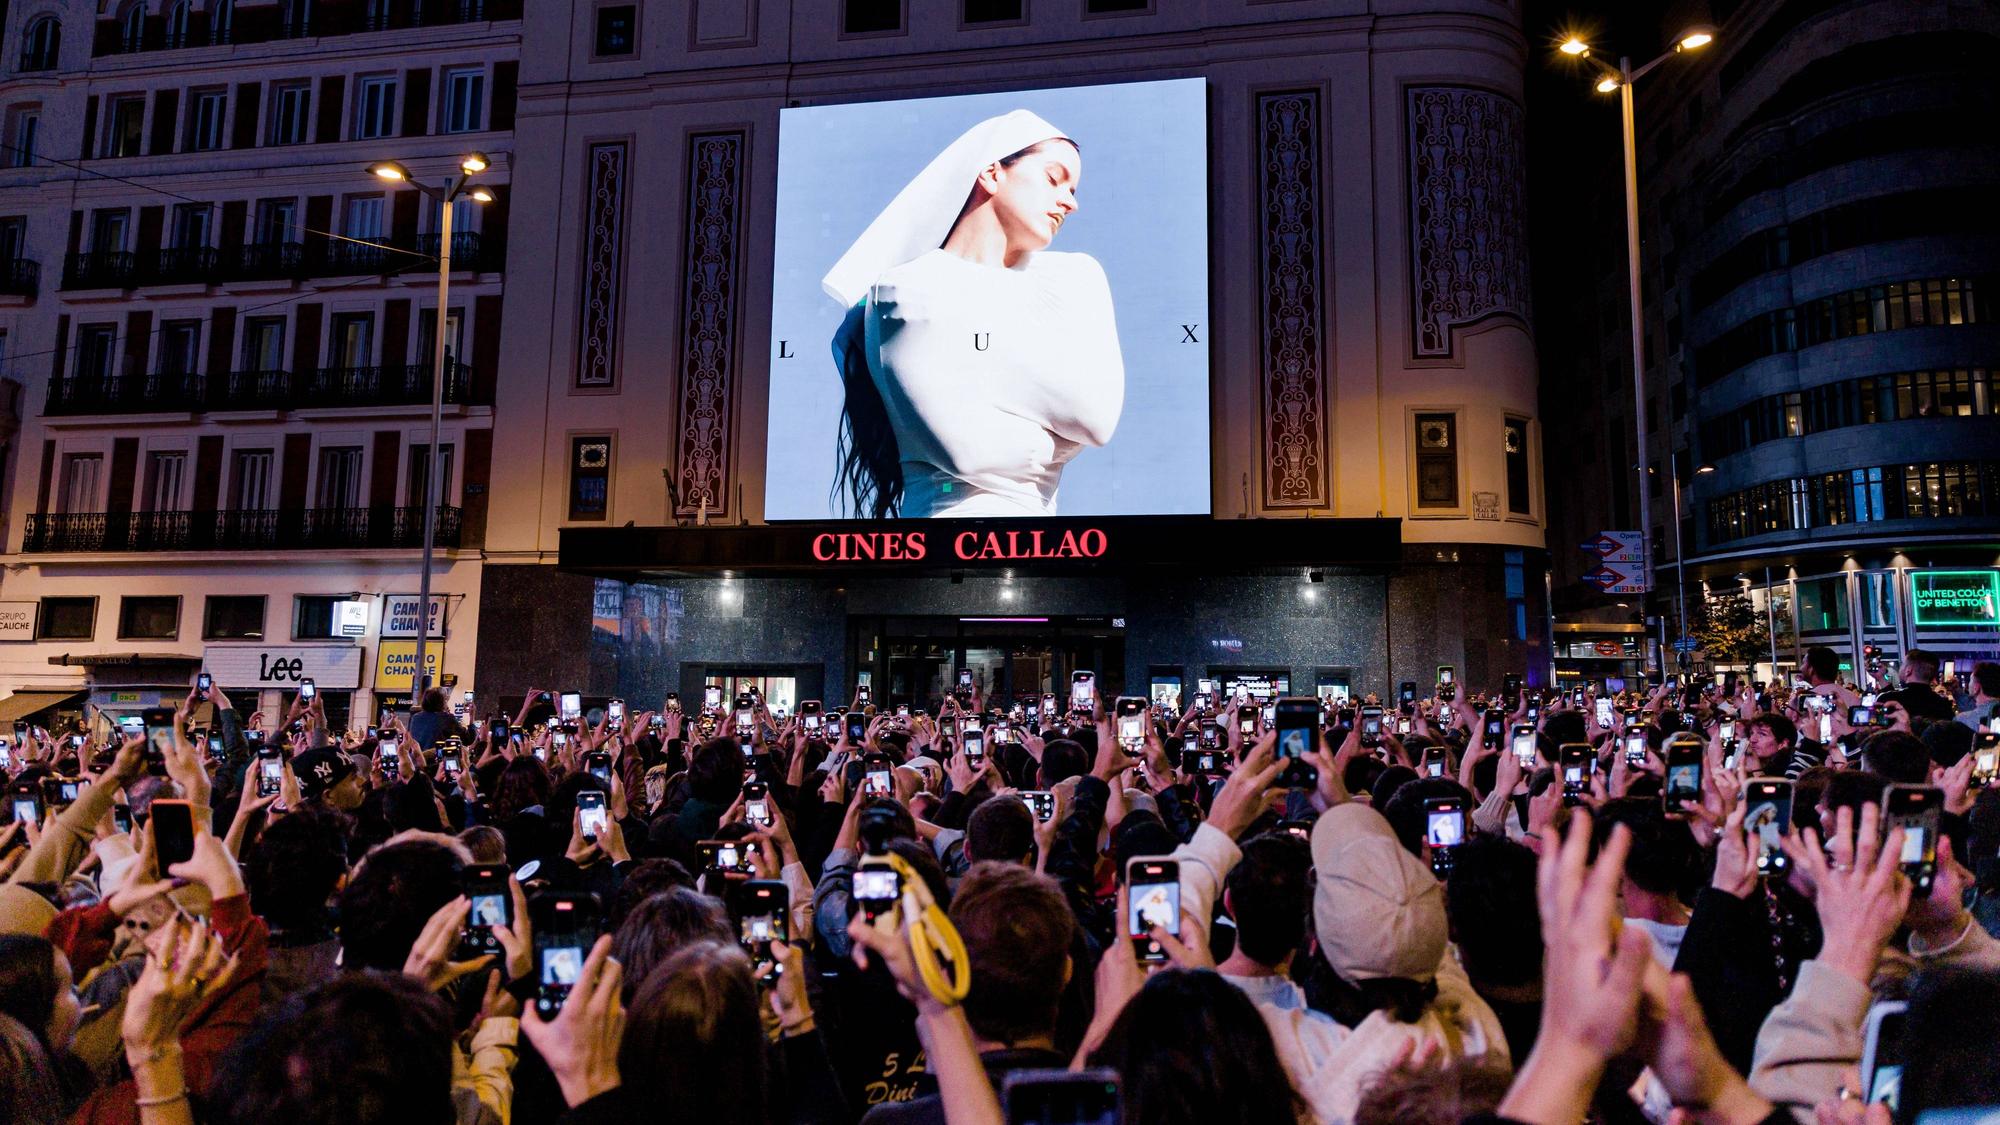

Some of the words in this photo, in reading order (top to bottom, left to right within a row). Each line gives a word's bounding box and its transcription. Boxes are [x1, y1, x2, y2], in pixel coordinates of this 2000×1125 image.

[778, 340, 794, 359] L
[973, 333, 990, 352] U
[1181, 324, 1199, 344] X
[812, 532, 926, 561] CINES
[954, 528, 1108, 560] CALLAO
[1917, 589, 1956, 598] UNITED
[1918, 599, 1933, 607] OF
[1934, 598, 1987, 607] BENETTON
[0, 612, 26, 620] GRUPO
[0, 622, 30, 630] CALICHE
[259, 653, 303, 681] Lee
